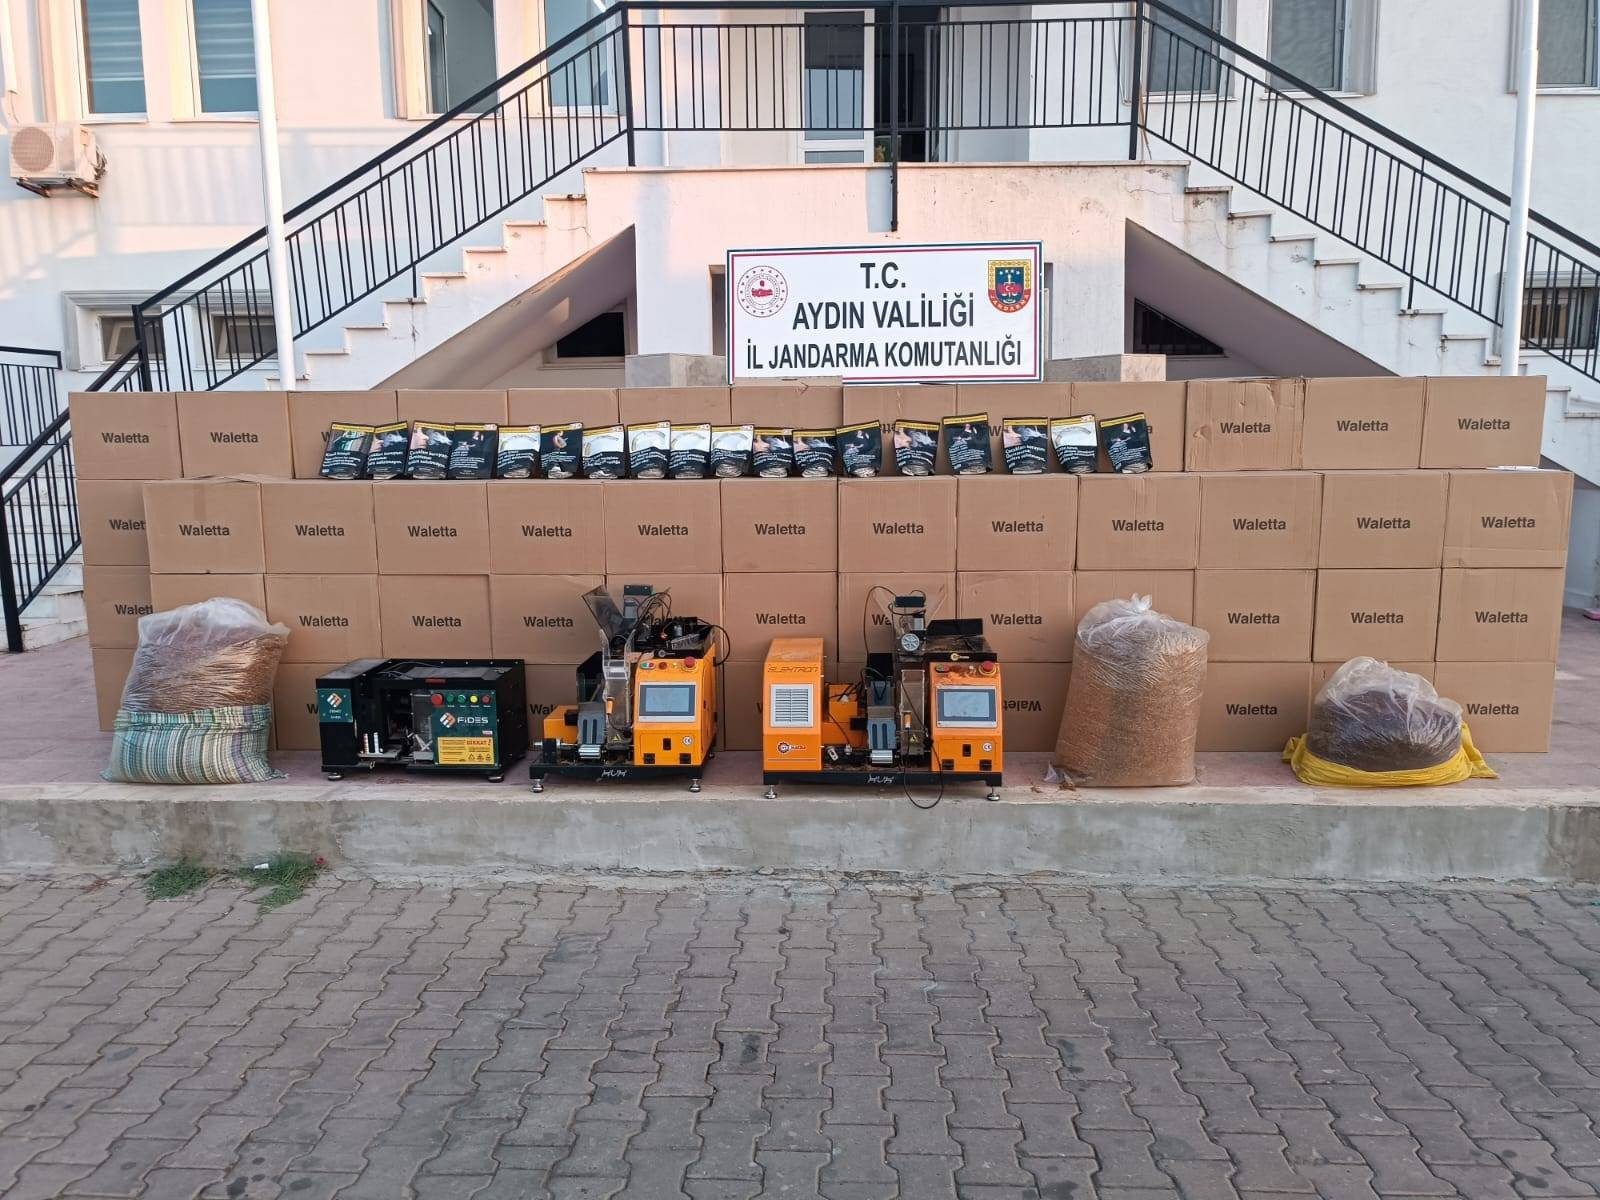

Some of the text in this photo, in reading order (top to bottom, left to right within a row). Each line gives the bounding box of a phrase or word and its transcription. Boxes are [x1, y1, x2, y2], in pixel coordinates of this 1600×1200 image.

[860, 262, 906, 289] T.C.
[793, 292, 974, 330] AYDIN VALİLİĞİ
[747, 334, 1021, 370] İL JANDARMA KOMUTANLIĞI
[1219, 421, 1271, 434] Waletta
[1336, 419, 1389, 432] Waletta
[1457, 418, 1511, 431] Waletta
[101, 432, 150, 444] Waletta
[210, 431, 259, 444] Waletta
[108, 519, 147, 531] Walet
[872, 522, 924, 535] Waletta
[991, 520, 1044, 533] Waletta
[1111, 519, 1165, 532] Waletta
[1232, 518, 1287, 531] Waletta
[1356, 517, 1411, 530] Waletta
[1481, 516, 1536, 529] Waletta
[178, 524, 230, 537] Waletta
[295, 524, 345, 537] Waletta
[407, 525, 458, 538] Waletta
[521, 525, 572, 538] Waletta
[637, 524, 689, 537] Waletta
[754, 523, 806, 536] Waletta
[298, 615, 349, 627] Waletta
[411, 615, 462, 628] Waletta
[523, 615, 574, 628] Waletta
[755, 613, 806, 625] Waletta
[990, 613, 1043, 626] Waletta
[1227, 612, 1280, 625] Waletta
[1350, 611, 1404, 624] Waletta
[1474, 611, 1528, 624] Waletta
[1004, 699, 1042, 712] Walet
[1226, 703, 1278, 716] Waletta
[1466, 703, 1520, 716] Waletta
